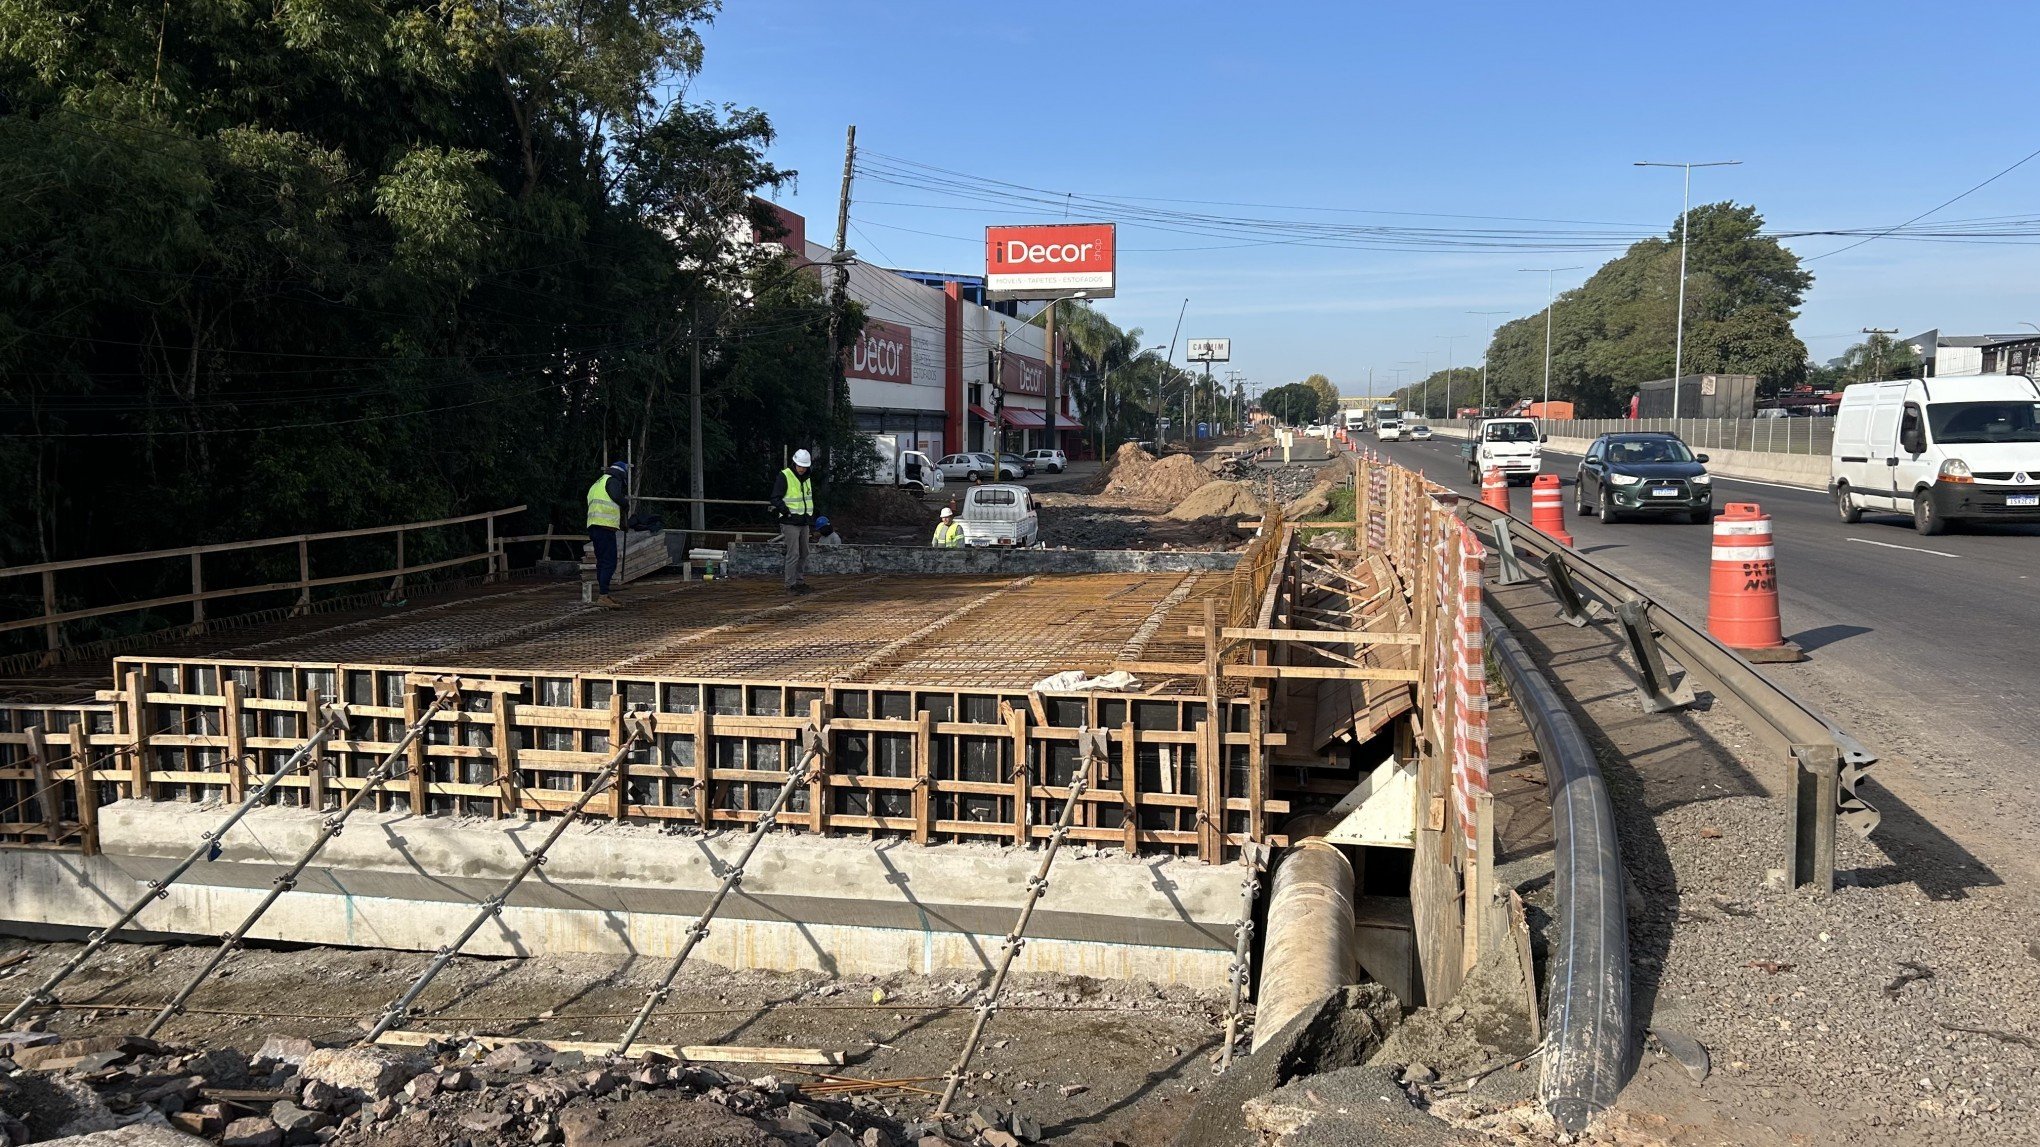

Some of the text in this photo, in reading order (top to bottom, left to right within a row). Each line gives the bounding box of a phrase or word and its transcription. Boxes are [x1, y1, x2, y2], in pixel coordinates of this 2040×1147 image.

[1094, 238, 1102, 261] shop
[854, 330, 903, 377] Decor
[1020, 360, 1042, 392] Decor
